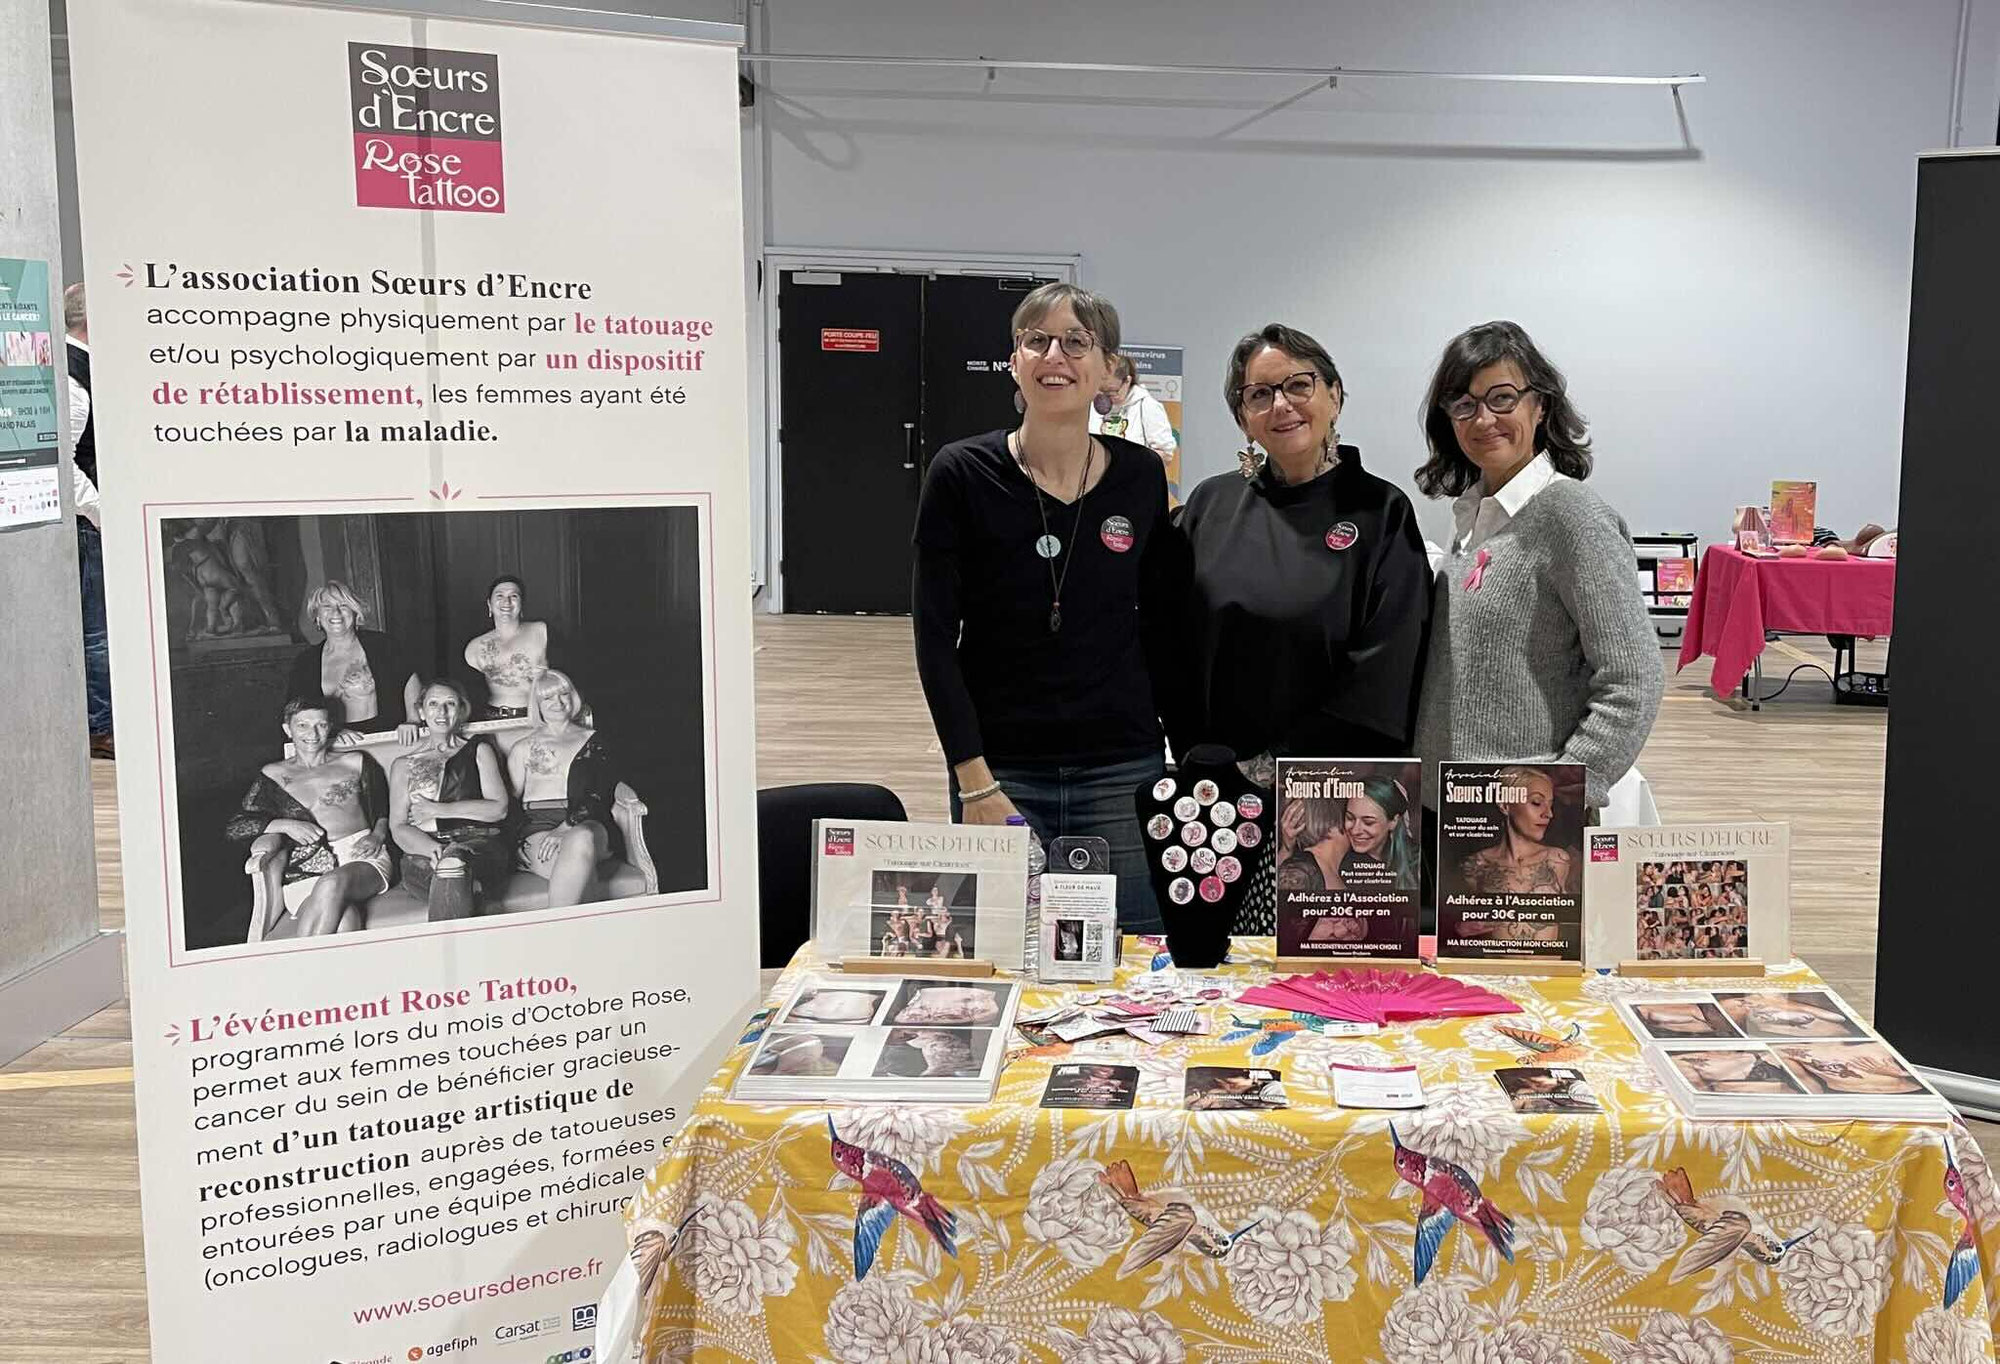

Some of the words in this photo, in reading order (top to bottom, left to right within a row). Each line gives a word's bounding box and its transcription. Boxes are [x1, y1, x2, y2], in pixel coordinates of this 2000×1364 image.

[360, 49, 489, 93] Sœurs
[358, 89, 496, 135] d'Encre
[361, 138, 462, 176] Rose
[400, 171, 501, 208] Tattoo
[143, 262, 361, 294] L'association
[371, 269, 467, 297] Sœurs
[476, 272, 592, 300] d'Encre
[147, 306, 331, 333] accompagne
[340, 306, 520, 335] physiquement
[527, 316, 567, 337] par
[574, 311, 596, 334] le
[604, 314, 713, 343] tatouage
[149, 342, 220, 365] et/ou
[230, 343, 489, 373] psychologiquement
[497, 352, 537, 373] par
[546, 353, 578, 370] un
[587, 348, 706, 377] dispositif
[152, 381, 189, 405] de
[199, 381, 423, 410] rétablissement,
[432, 382, 468, 404] les
[475, 383, 572, 404] femmes
[579, 387, 643, 410] ayant
[650, 385, 687, 405] été
[153, 420, 284, 443] touchées
[293, 425, 337, 447] par
[344, 420, 371, 443] la
[380, 419, 498, 442] maladie.
[1285, 777, 1321, 799] Sœurs
[1323, 777, 1365, 799] d'Encre
[1446, 781, 1483, 803] Sœurs
[1485, 781, 1528, 804] d'Encre
[1352, 862, 1386, 870] TATOUAGE
[1287, 892, 1332, 903] Adhérez
[1333, 893, 1342, 903] à
[1343, 892, 1409, 904] l'Association
[1302, 908, 1328, 918] pour
[1330, 906, 1354, 916] 30€
[1355, 908, 1374, 919] par
[1375, 908, 1391, 916] an
[1446, 894, 1493, 906] Adhérez
[1495, 895, 1503, 906] à
[1505, 895, 1575, 907] l'Association
[1462, 911, 1490, 921] pour
[1491, 909, 1516, 920] 30€
[1517, 911, 1539, 921] par
[1540, 912, 1556, 921] an
[1446, 939, 1459, 947] MA
[1522, 940, 1541, 948] MON
[190, 994, 391, 1043] L'événement
[400, 989, 471, 1014] Rose
[478, 975, 578, 1003] Tattoo,
[191, 1032, 345, 1078] programmé
[354, 1029, 399, 1050] lors
[407, 1020, 438, 1041] du
[447, 1012, 504, 1036] mois
[511, 996, 624, 1027] d'Octobre
[632, 988, 691, 1009] Rose,
[193, 1071, 289, 1108] permet
[297, 1066, 343, 1086] aux
[349, 1050, 451, 1079] femmes
[457, 1032, 568, 1062] touchées
[575, 1025, 613, 1050] par
[620, 1021, 647, 1038] un
[194, 1103, 287, 1131] cancer
[294, 1094, 327, 1116] du
[336, 1086, 388, 1109] sein
[396, 1078, 429, 1100] de
[437, 1062, 556, 1094] bénéficier
[562, 1044, 681, 1079] gracieuse-
[196, 1139, 264, 1166] ment
[272, 1129, 339, 1155] d'un
[348, 1109, 466, 1142] tatouage
[474, 1087, 598, 1122] artistique
[605, 1078, 634, 1100] de
[198, 1152, 410, 1203] reconstruction
[420, 1135, 505, 1164] auprès
[512, 1127, 543, 1147] de
[549, 1107, 676, 1141] tatoueuses
[201, 1180, 421, 1238] professionnelles,
[428, 1157, 555, 1191] engagées,
[561, 1138, 655, 1168] formées
[202, 1224, 335, 1260] entourées
[344, 1214, 386, 1241] par
[394, 1205, 440, 1226] une
[448, 1188, 532, 1217] équipe
[540, 1164, 645, 1199] médicale
[204, 1247, 368, 1292] (oncologues,
[377, 1218, 519, 1258] radiologues
[526, 1210, 549, 1228] et
[353, 1257, 603, 1324] www.soeursdencre.fr
[426, 1335, 478, 1358] agefiph
[494, 1320, 540, 1339] Carsat
